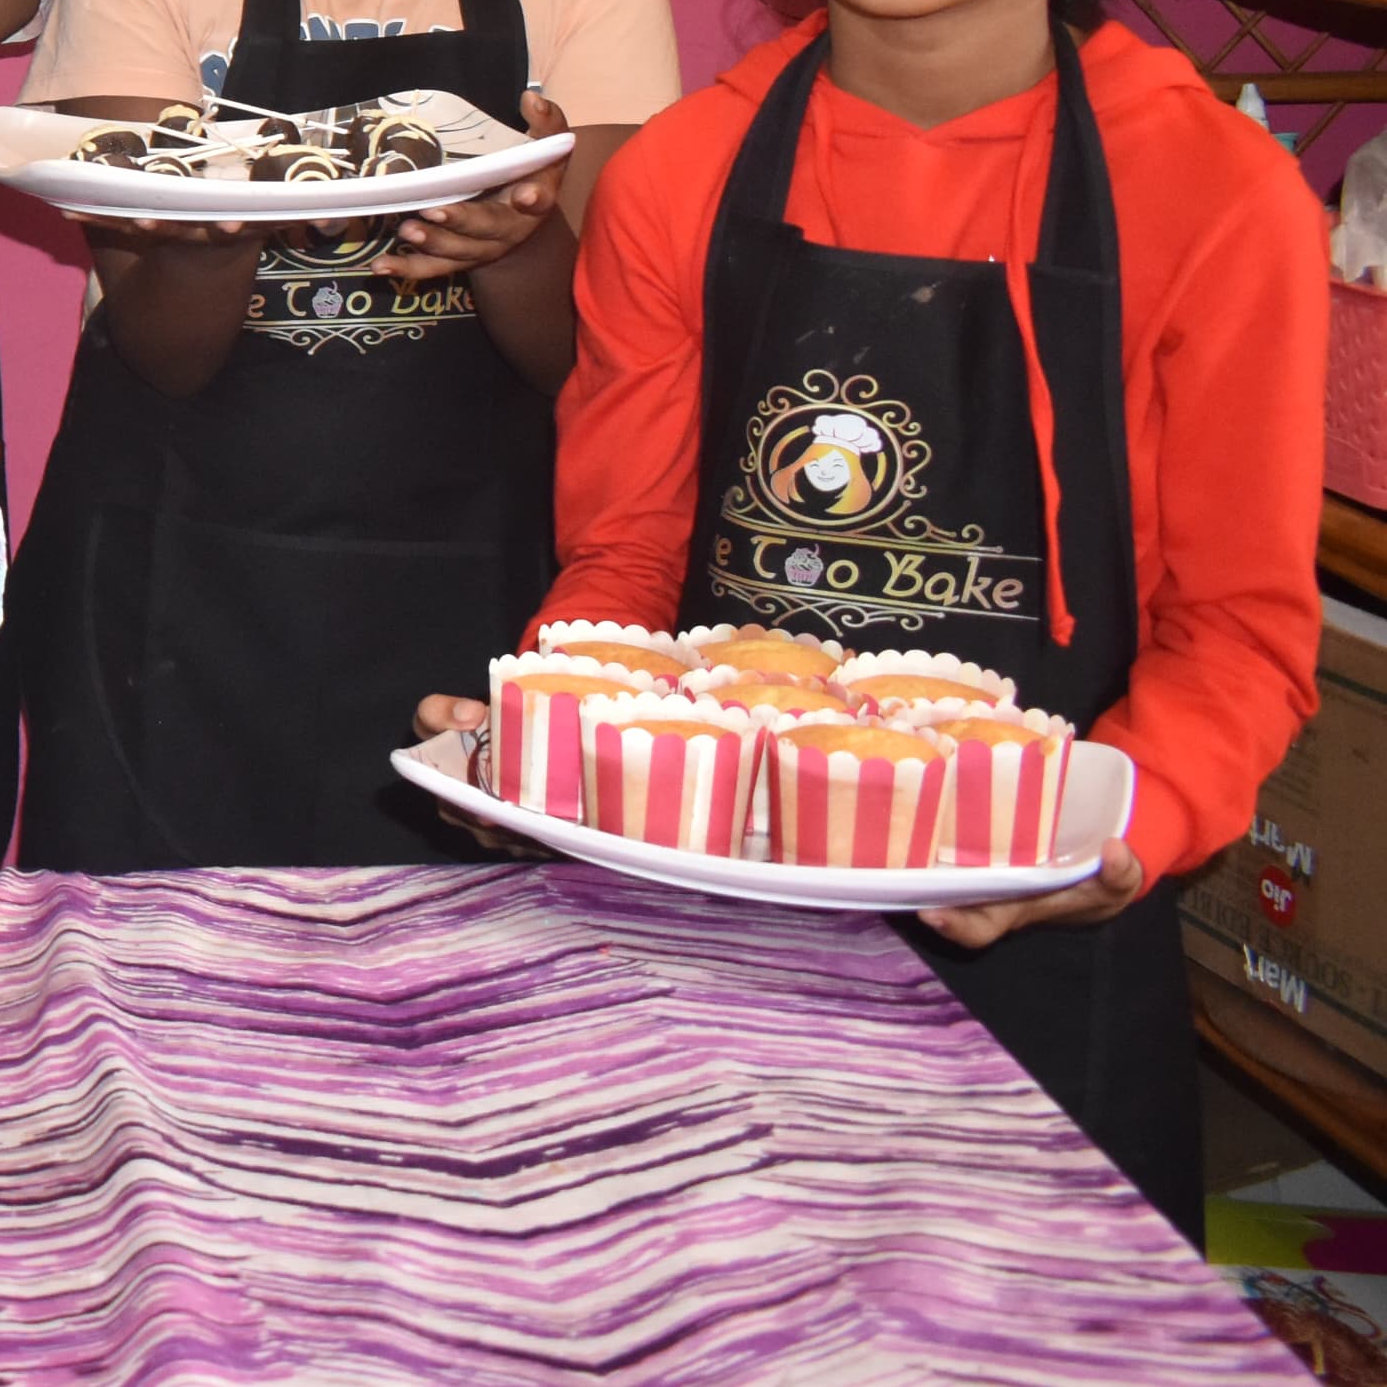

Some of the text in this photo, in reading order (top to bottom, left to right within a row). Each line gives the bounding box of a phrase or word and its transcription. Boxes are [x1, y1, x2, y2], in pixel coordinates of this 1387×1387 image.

[883, 551, 1024, 610] Bake
[1261, 879, 1292, 913] Jio
[1243, 942, 1308, 1014] Mart
